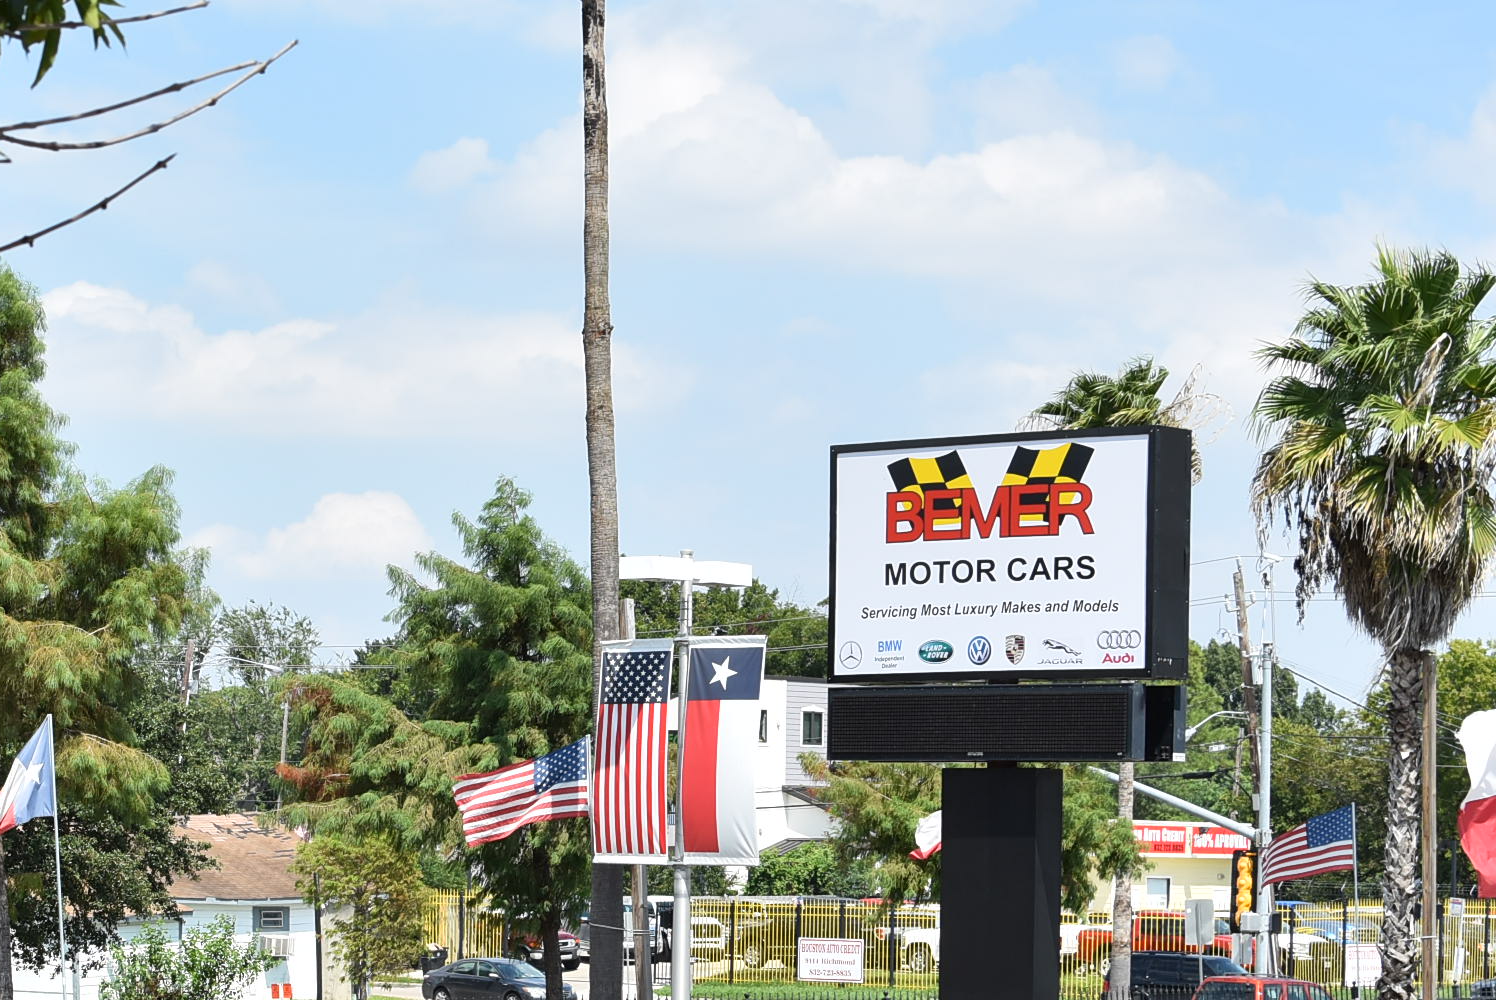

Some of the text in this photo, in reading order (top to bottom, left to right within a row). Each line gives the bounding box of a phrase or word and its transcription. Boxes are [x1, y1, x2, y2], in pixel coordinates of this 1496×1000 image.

[885, 482, 1094, 544] BEMER
[885, 555, 1095, 586] MOTOR CARS
[861, 600, 1119, 620] Servicing Most Luxury Makes and Models
[877, 640, 903, 653] BMW
[1101, 653, 1135, 664] Audi
[801, 943, 861, 954] HOUSTON AUTO CREDIT
[821, 957, 855, 965] Richmond
